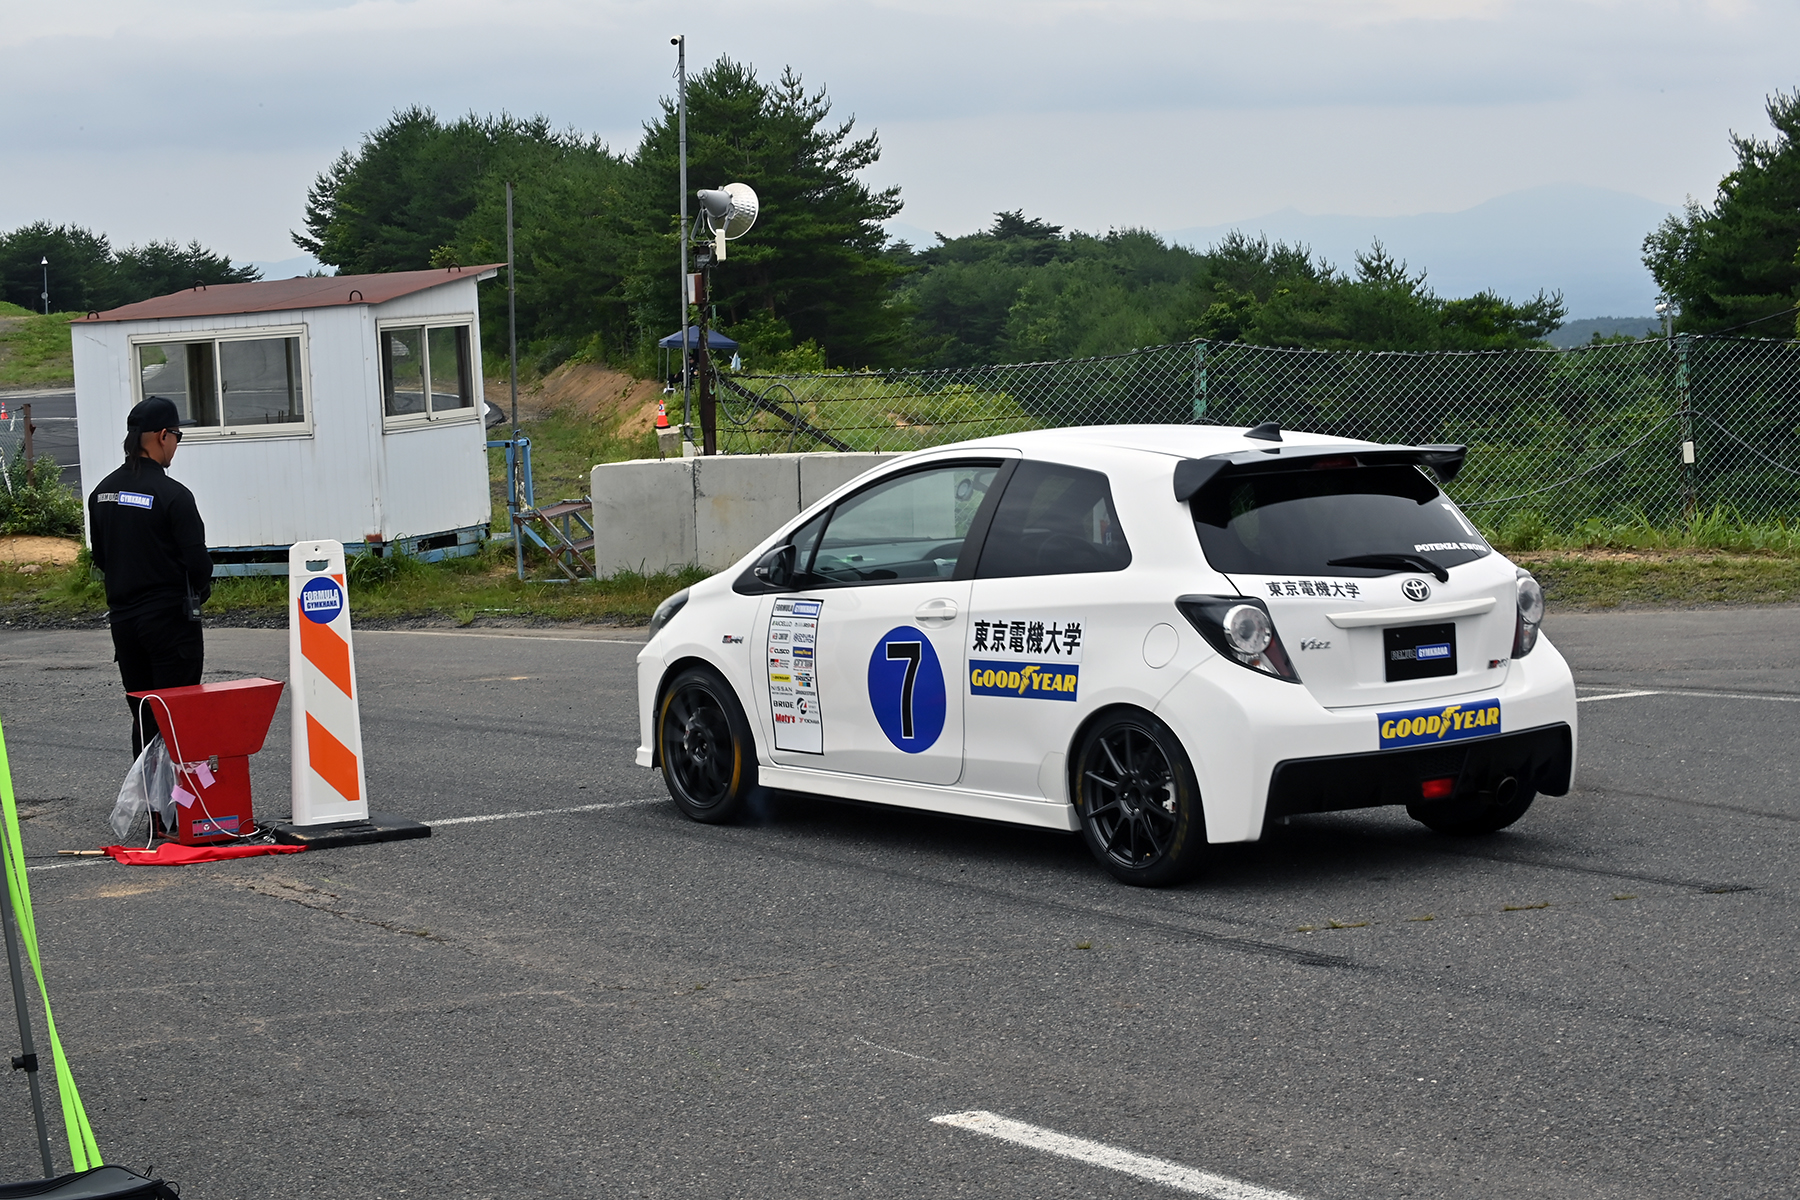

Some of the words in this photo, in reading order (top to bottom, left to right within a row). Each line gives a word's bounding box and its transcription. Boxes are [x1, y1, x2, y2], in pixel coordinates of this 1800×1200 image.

[1414, 542, 1460, 552] POTENZA
[303, 589, 339, 601] FORMULA
[1265, 580, 1360, 598] 東京電機大学
[306, 600, 337, 609] GYMKHANA
[973, 619, 1082, 656] 東京電機大学
[1418, 646, 1449, 657] GYMKHANA
[971, 666, 1077, 692] GOODYEAR
[886, 641, 922, 739] 7
[773, 700, 794, 709] BRIDE
[775, 713, 796, 724] Moty's
[1381, 706, 1500, 739] GOODYEAR
